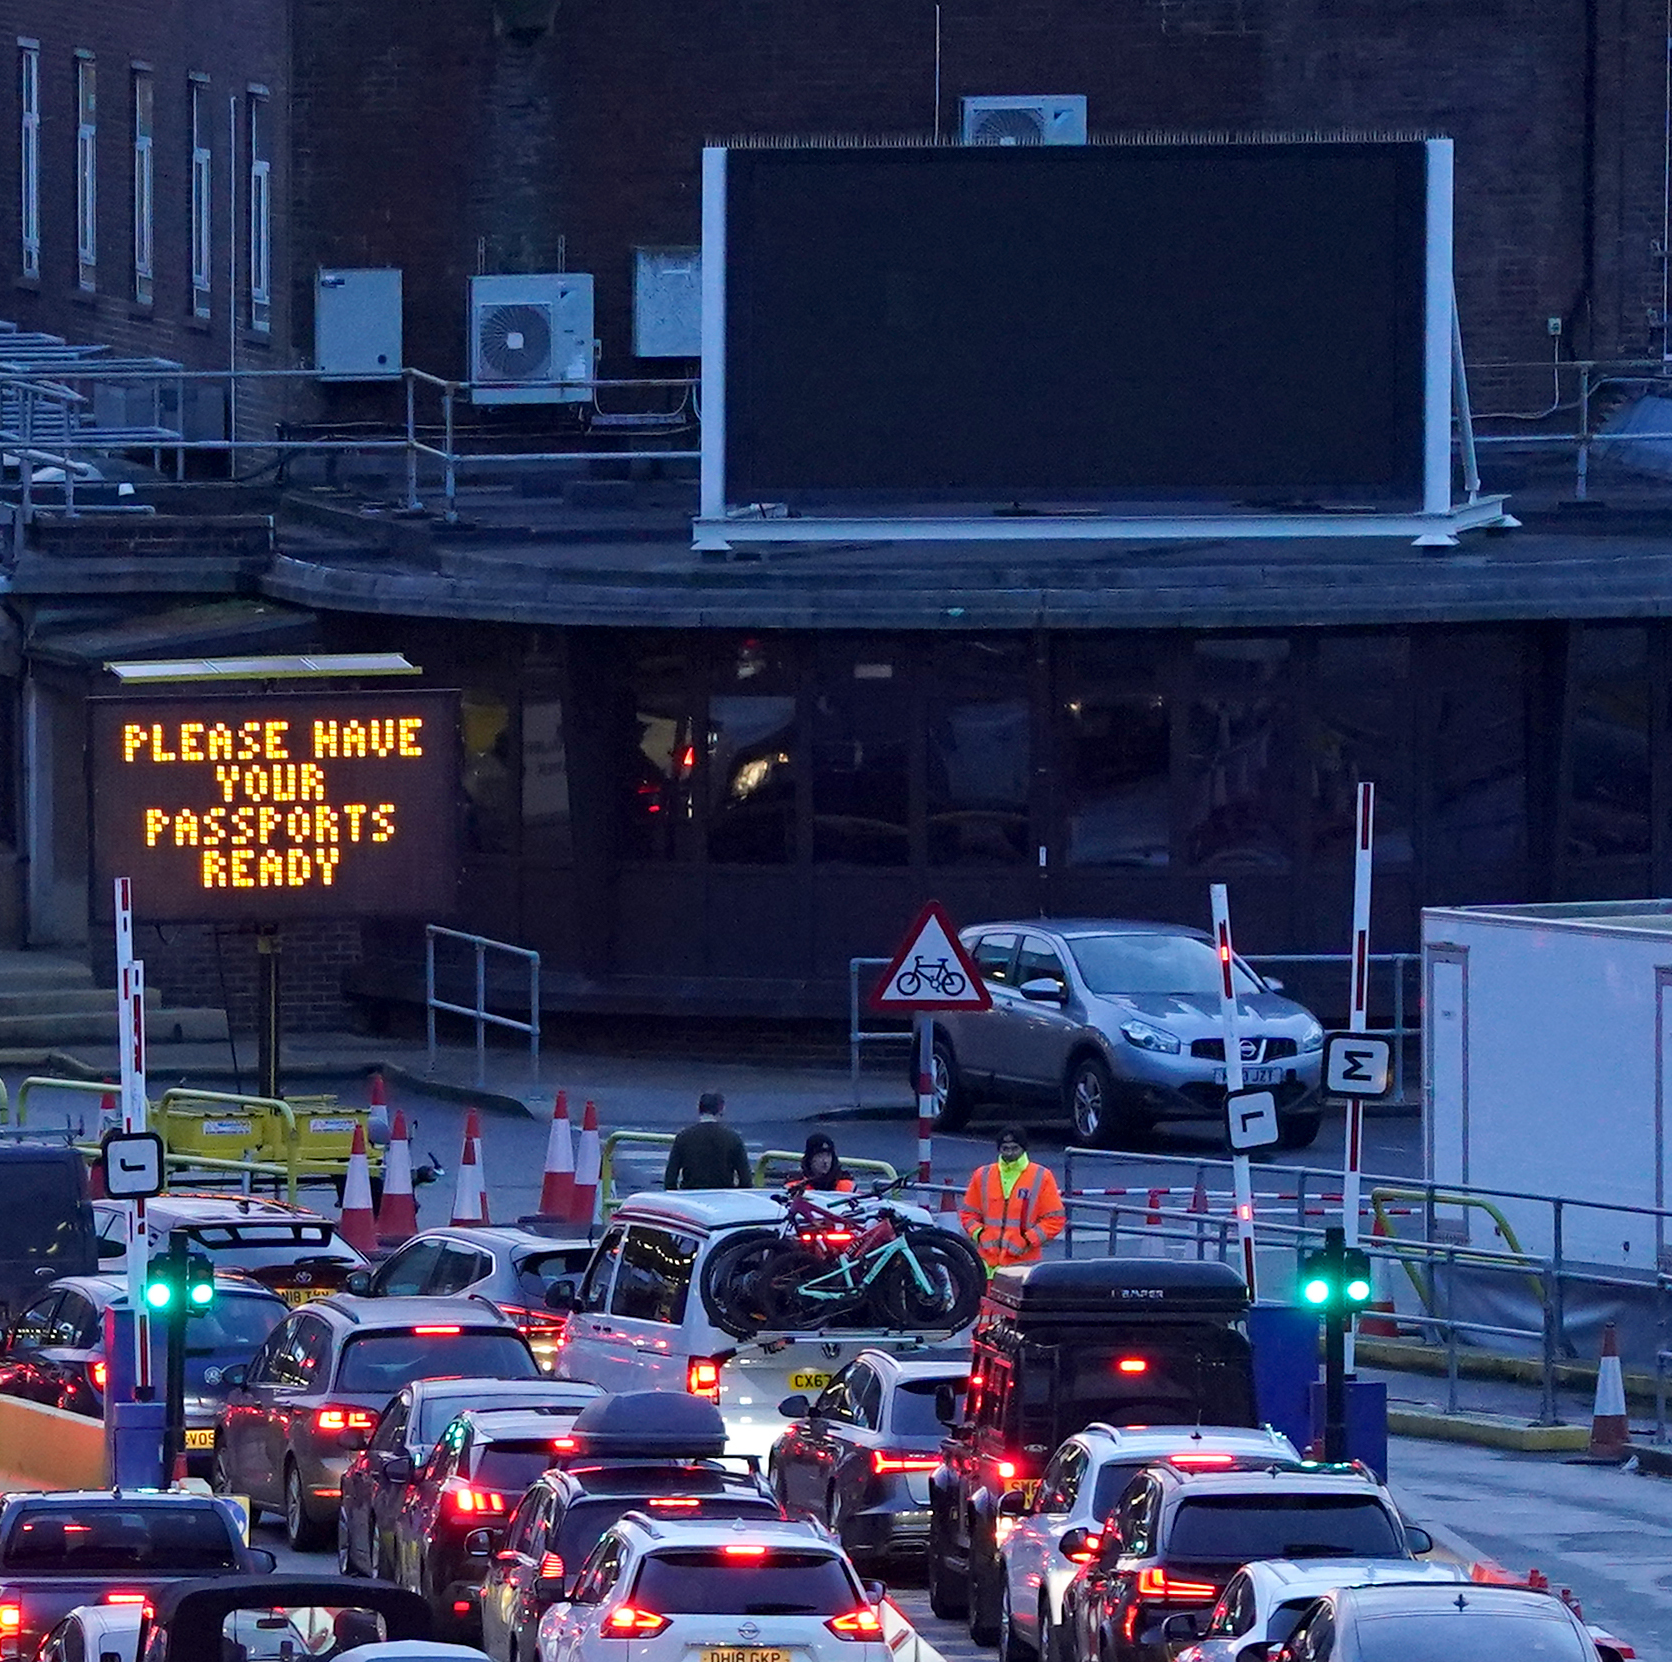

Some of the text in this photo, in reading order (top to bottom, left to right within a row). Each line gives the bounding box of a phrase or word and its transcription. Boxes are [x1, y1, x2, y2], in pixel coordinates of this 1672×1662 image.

[124, 718, 423, 762] PLEASE HAVE
[216, 763, 325, 803] YOUR
[146, 803, 396, 847] PASSPORTS
[203, 847, 340, 888] READY
[1343, 1050, 1374, 1081] M
[1241, 1111, 1264, 1133] L
[120, 1157, 146, 1172] J
